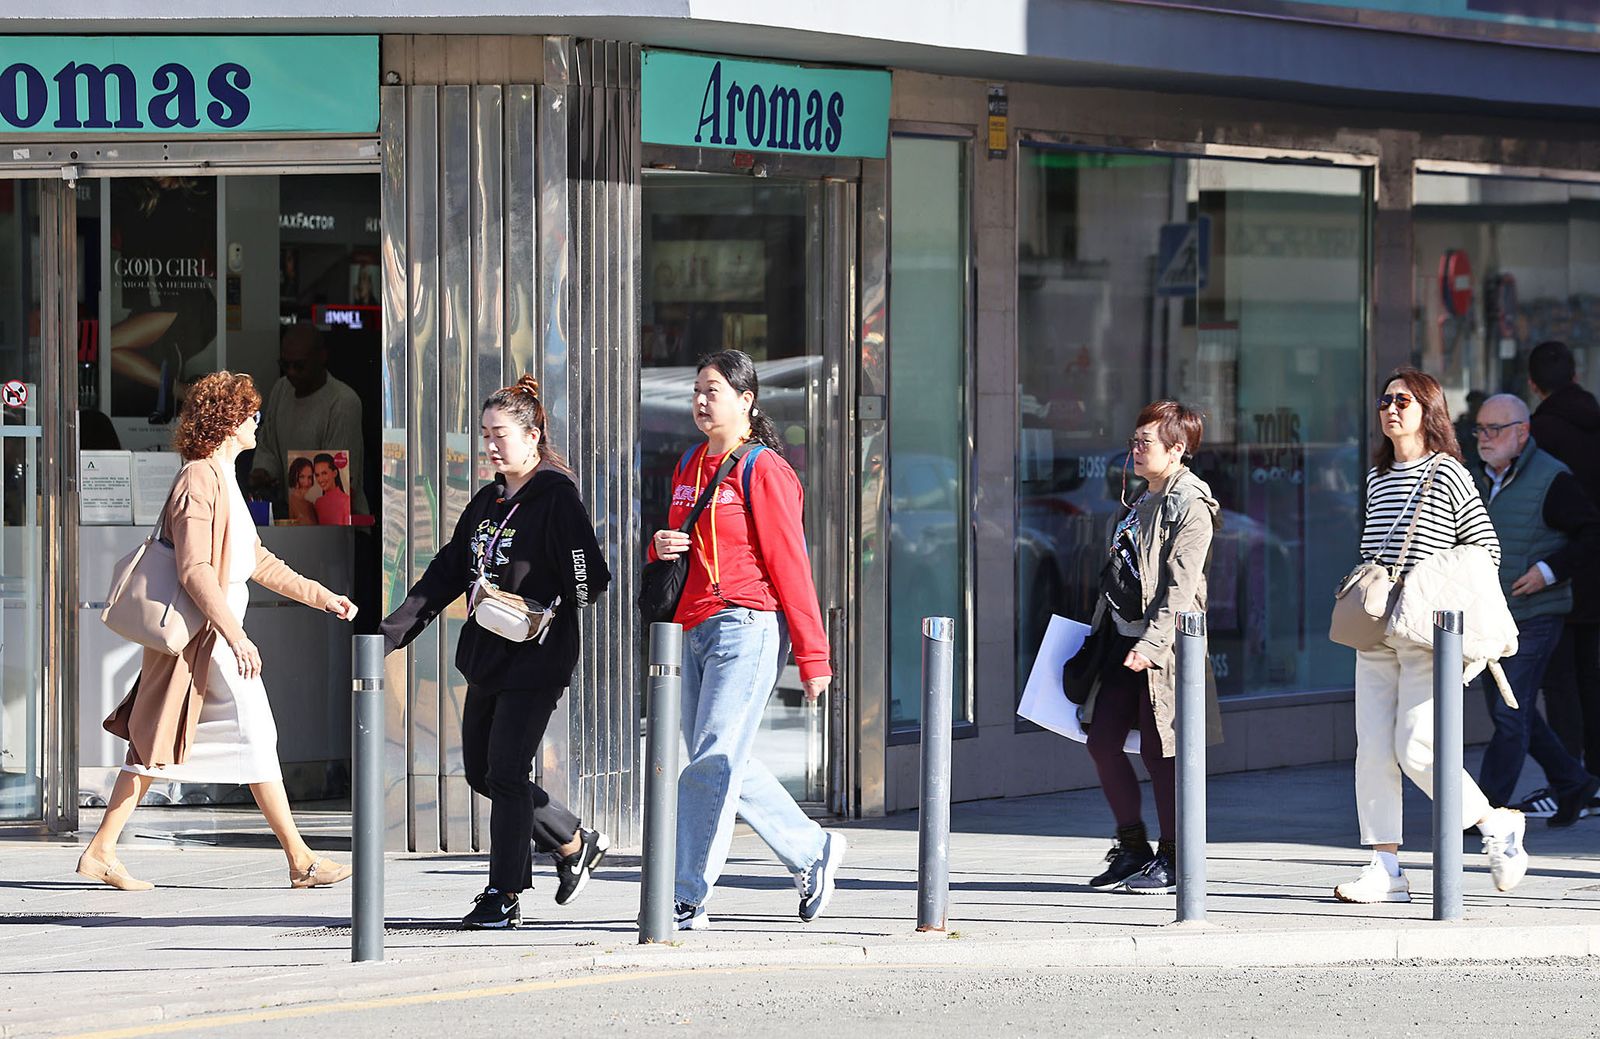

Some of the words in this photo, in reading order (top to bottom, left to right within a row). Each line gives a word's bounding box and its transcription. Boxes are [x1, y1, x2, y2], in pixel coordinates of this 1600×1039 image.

[0, 61, 252, 129] omas
[694, 60, 845, 153] Aromas
[114, 258, 163, 277] GOOD
[166, 258, 214, 277] GIRL
[1078, 456, 1106, 478] BOSS
[571, 549, 587, 582] LEGEND
